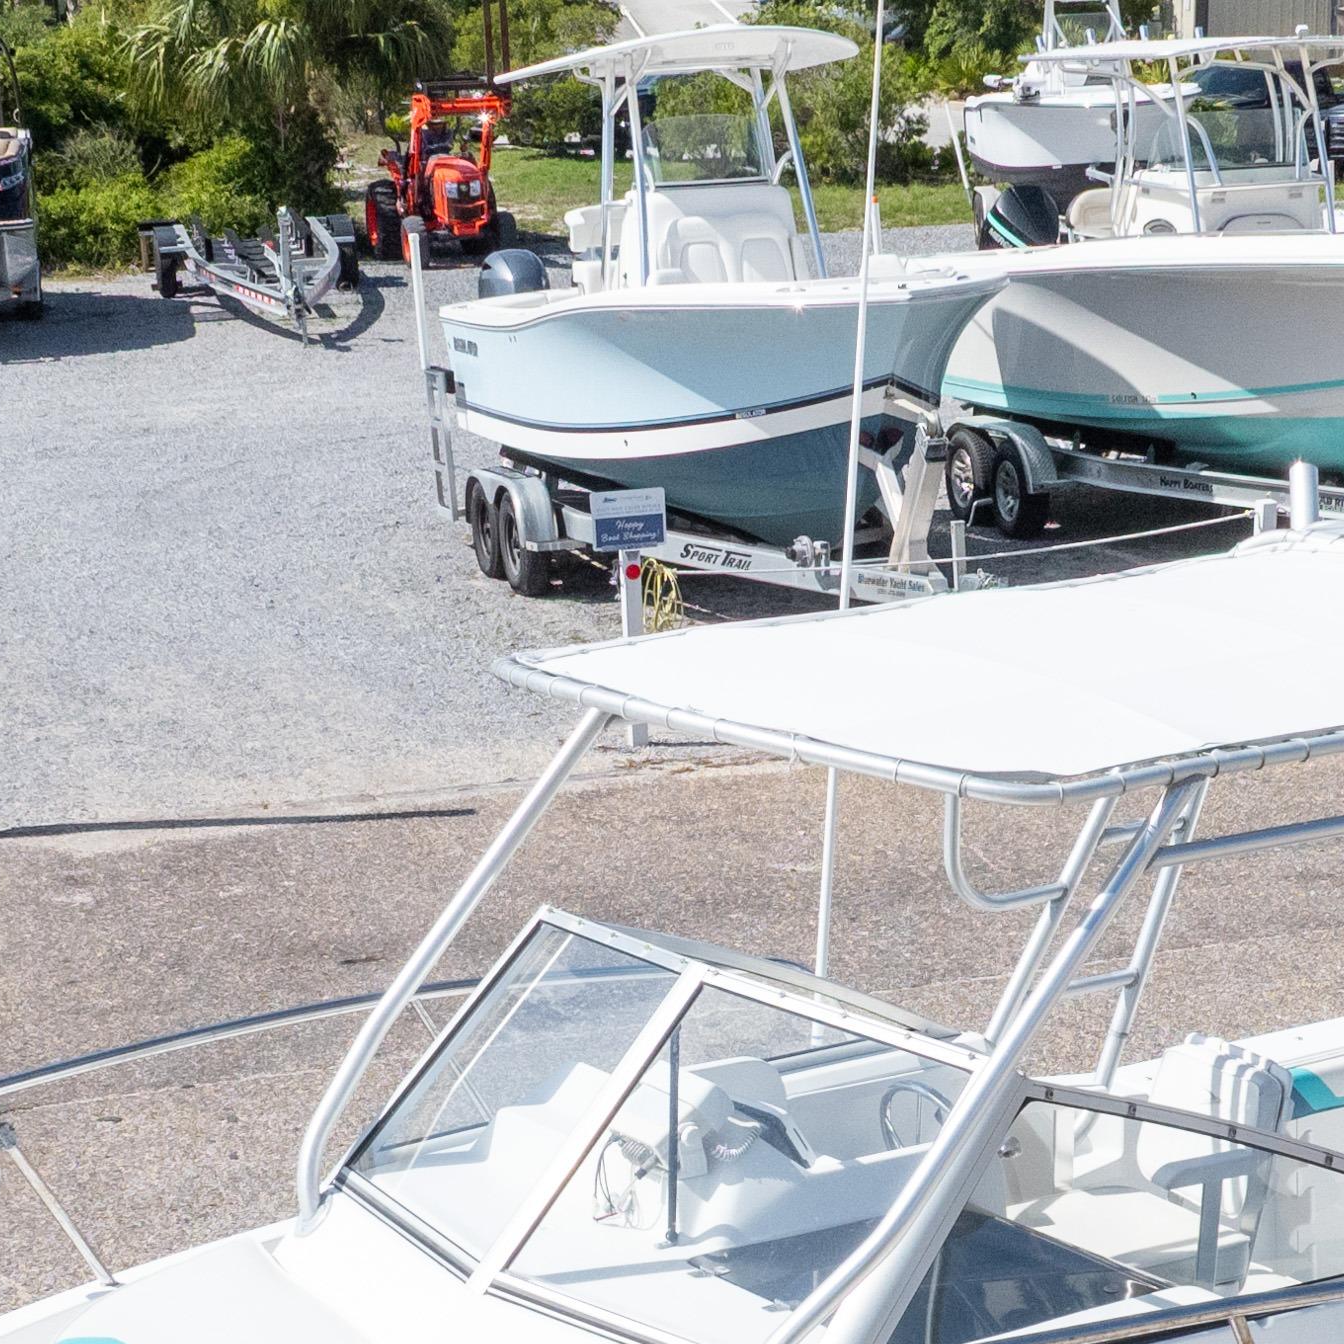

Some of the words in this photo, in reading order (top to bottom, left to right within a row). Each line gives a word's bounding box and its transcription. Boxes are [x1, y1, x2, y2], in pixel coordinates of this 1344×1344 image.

[616, 520, 645, 531] Happy
[600, 533, 620, 543] Boat
[679, 543, 723, 565] SPORT
[721, 550, 753, 571] TRAIL
[889, 577, 907, 590] Yacht
[908, 580, 925, 593] Sales
